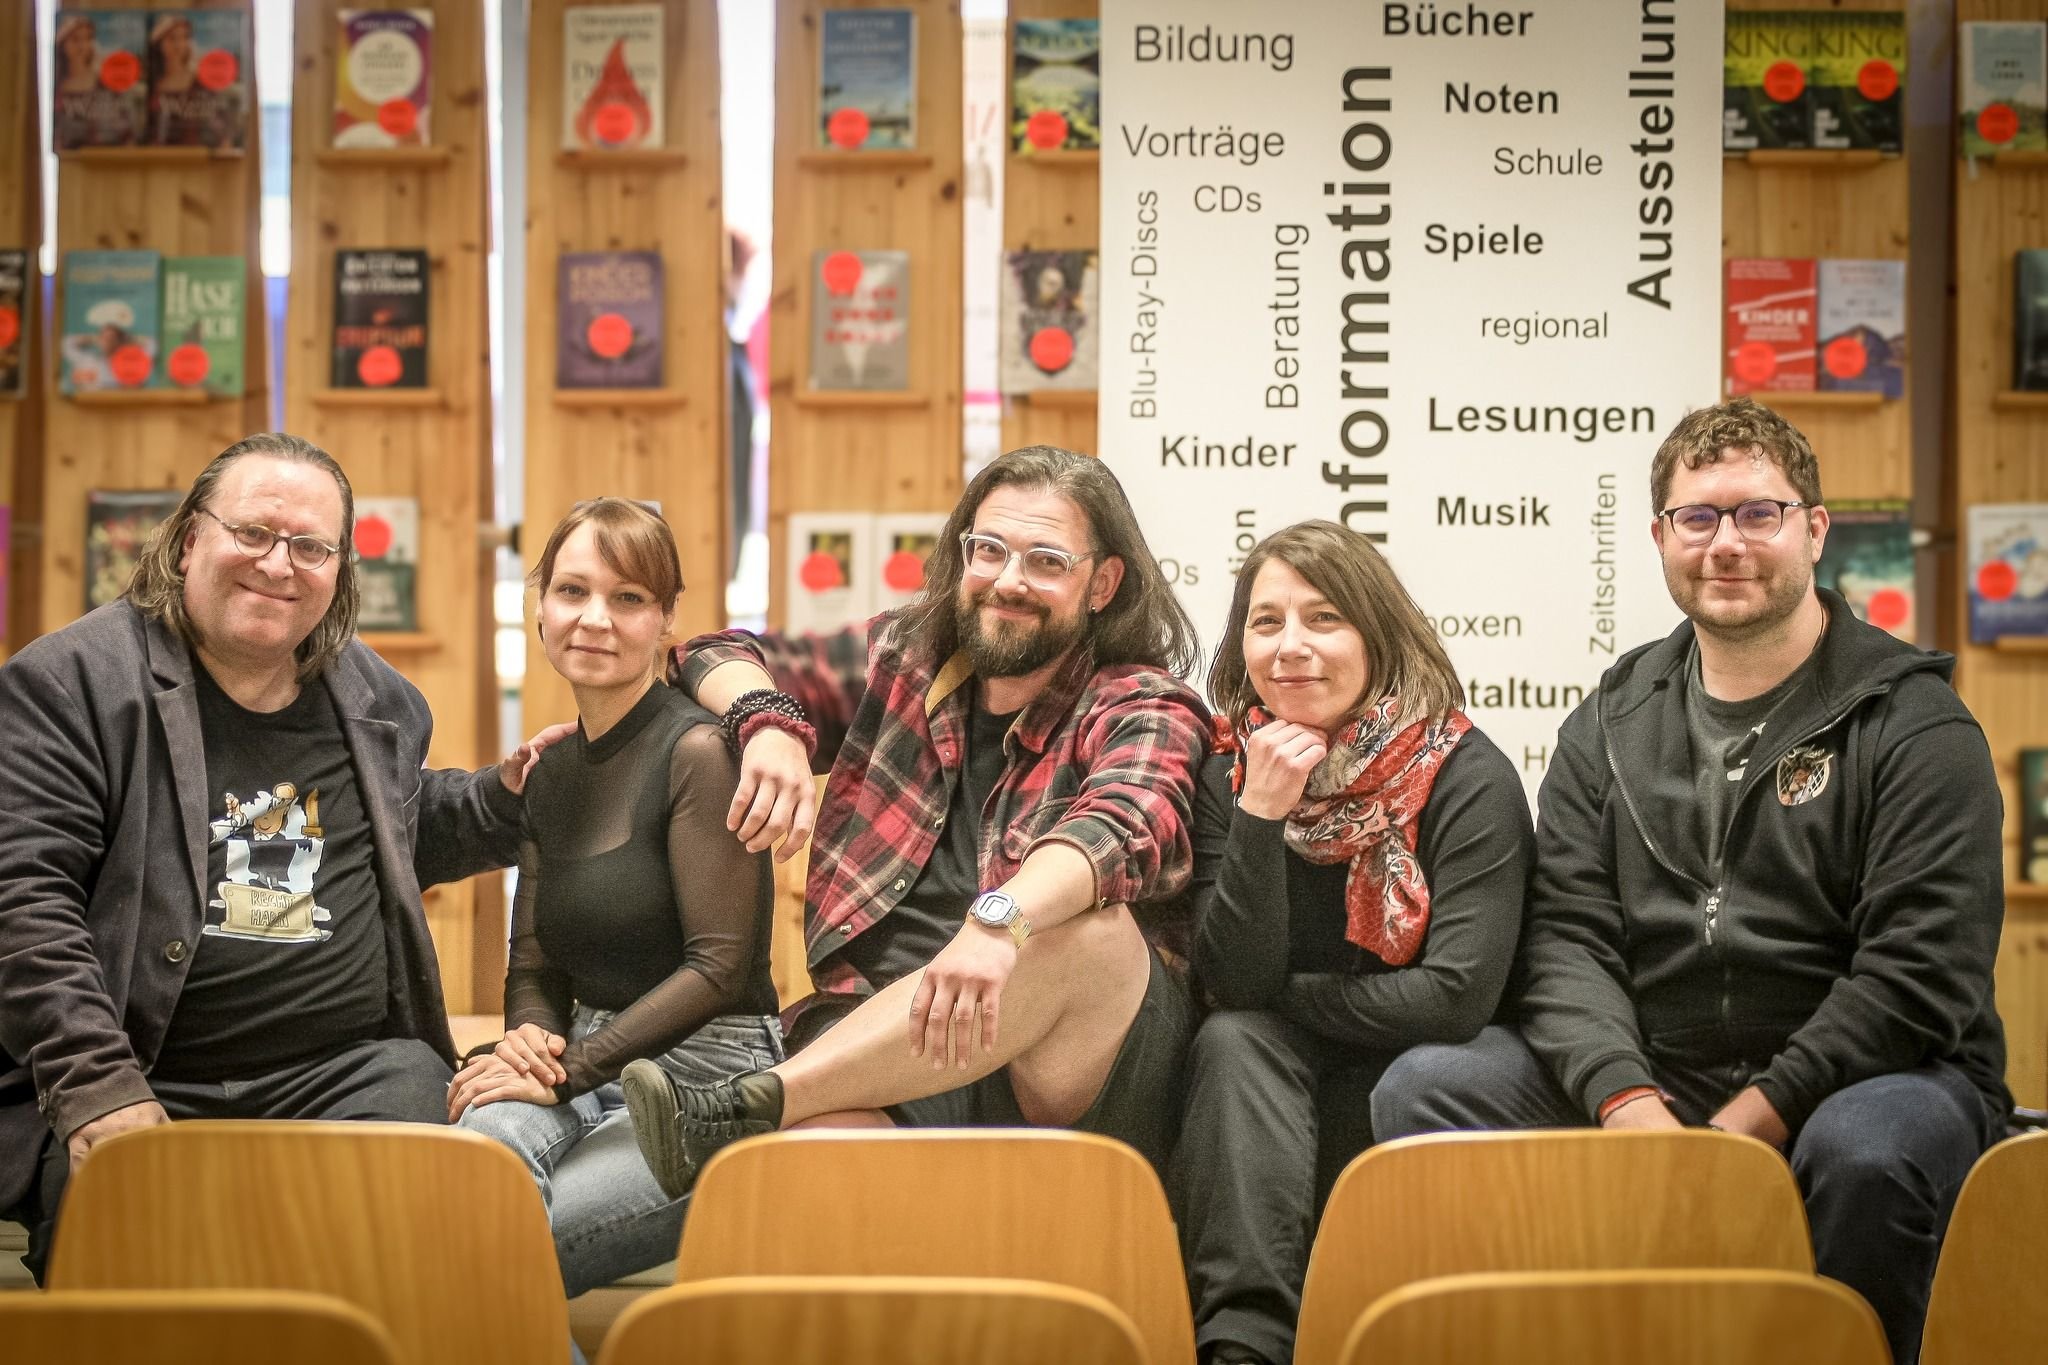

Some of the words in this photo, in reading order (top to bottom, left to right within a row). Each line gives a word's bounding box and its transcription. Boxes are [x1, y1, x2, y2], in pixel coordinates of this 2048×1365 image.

[1384, 2, 1534, 37] Bücher
[1135, 25, 1294, 72] Bildung
[1445, 82, 1559, 114] Noten
[1121, 123, 1285, 166] Vorträge
[1493, 146, 1603, 176] Schule
[1627, 0, 1677, 311] Ausstellun
[1194, 184, 1262, 213] CDs
[1424, 223, 1544, 262] Spiele
[1130, 189, 1165, 419] Blu-Ray-Discs
[1265, 223, 1310, 410] Beratung
[1322, 65, 1393, 544] nformation
[1738, 308, 1810, 326] KINDER
[1481, 311, 1608, 345] regional
[1429, 397, 1655, 443] Lesungen
[1161, 436, 1297, 468] Kinder
[1437, 496, 1551, 527] Musik
[1589, 473, 1617, 656] Zeitschriften
[1468, 676, 1599, 709] taltun
